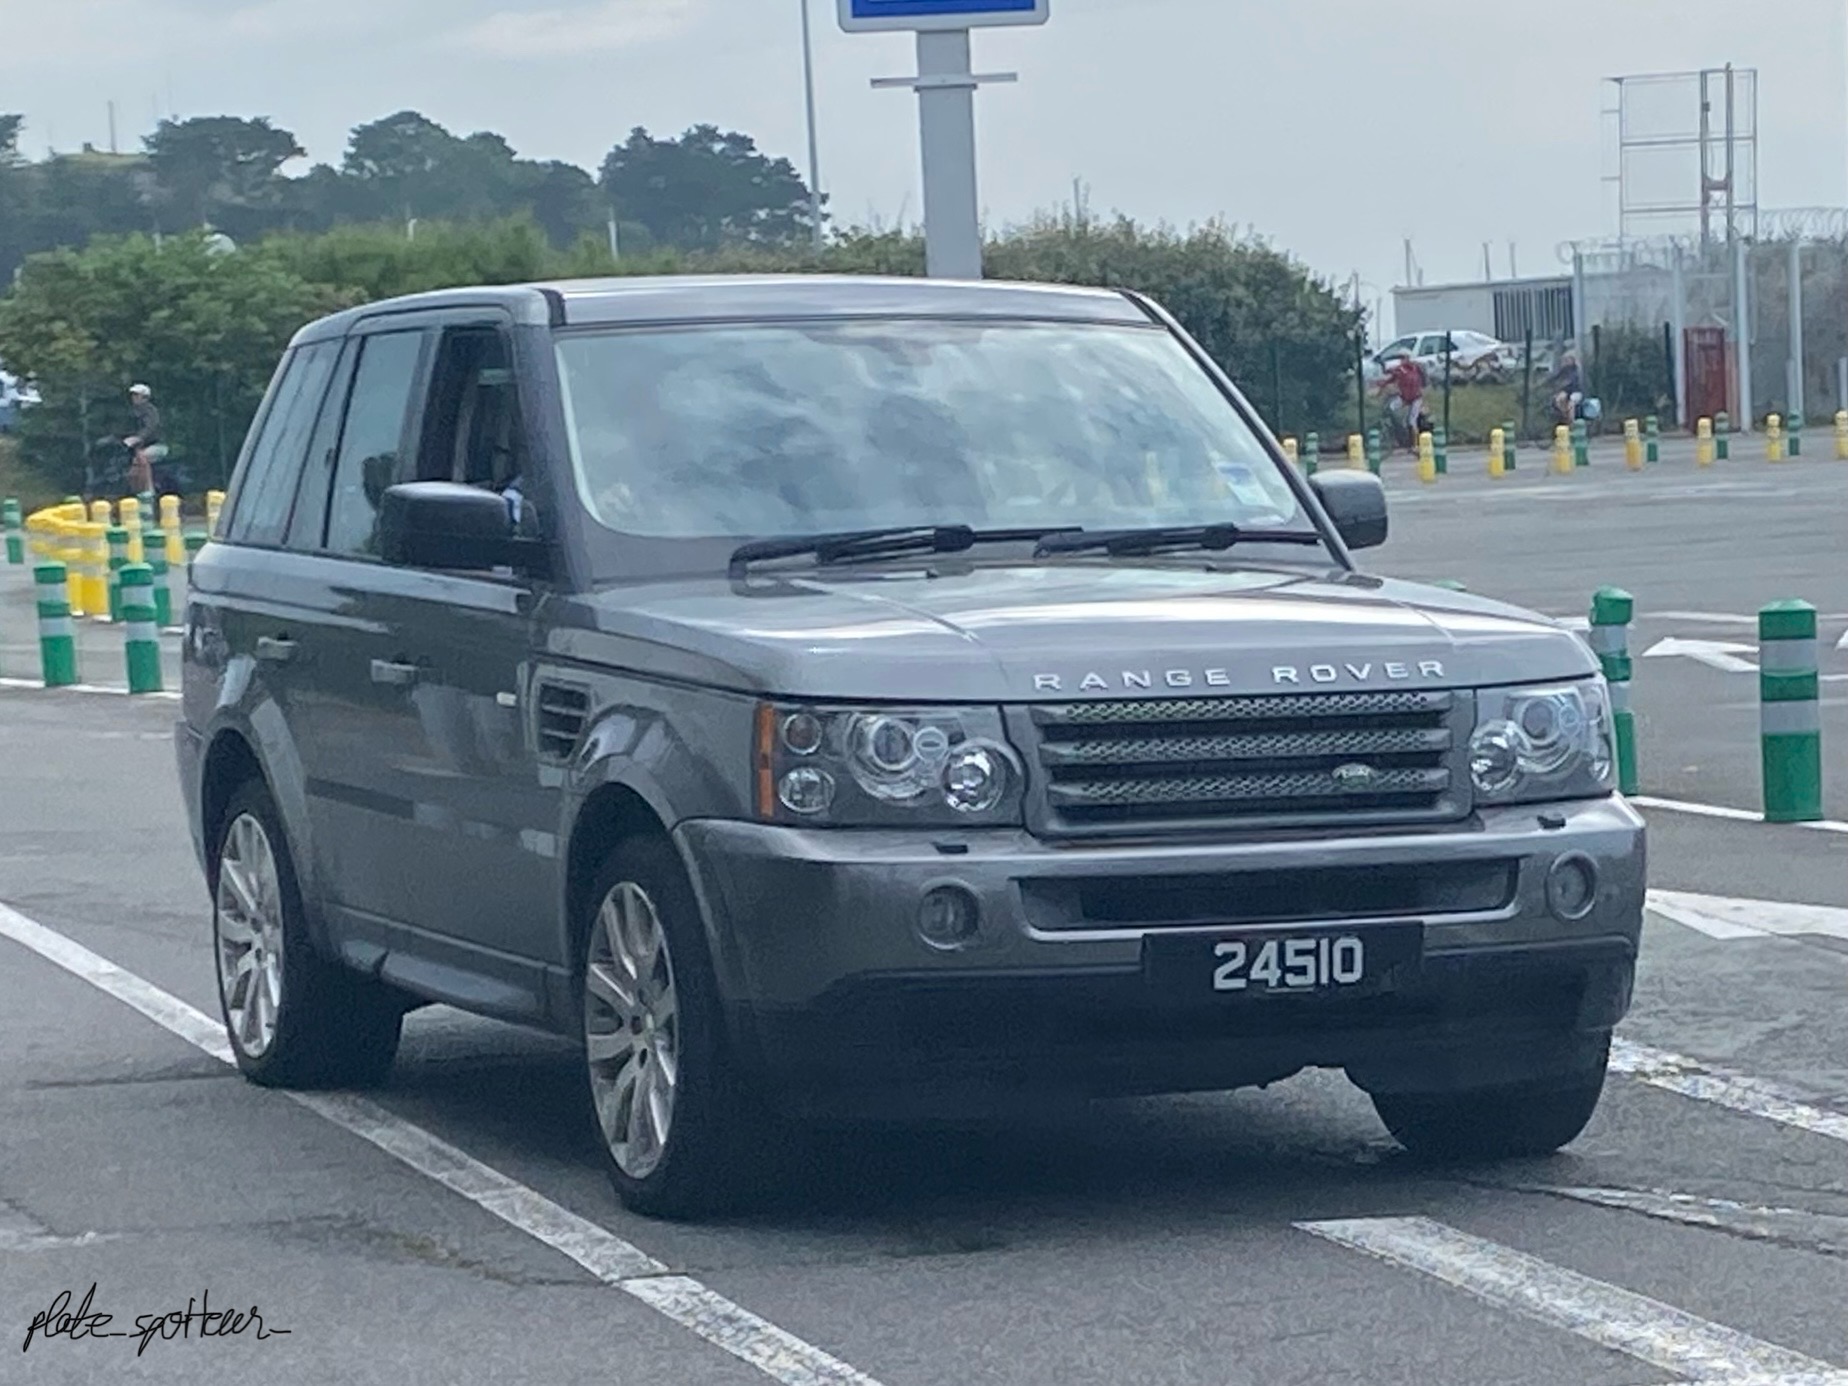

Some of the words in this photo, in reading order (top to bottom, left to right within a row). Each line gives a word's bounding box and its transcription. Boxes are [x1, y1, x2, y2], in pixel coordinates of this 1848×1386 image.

[1033, 669, 1231, 691] RANGE
[1272, 660, 1446, 683] ROVER
[1213, 937, 1363, 990] 24510
